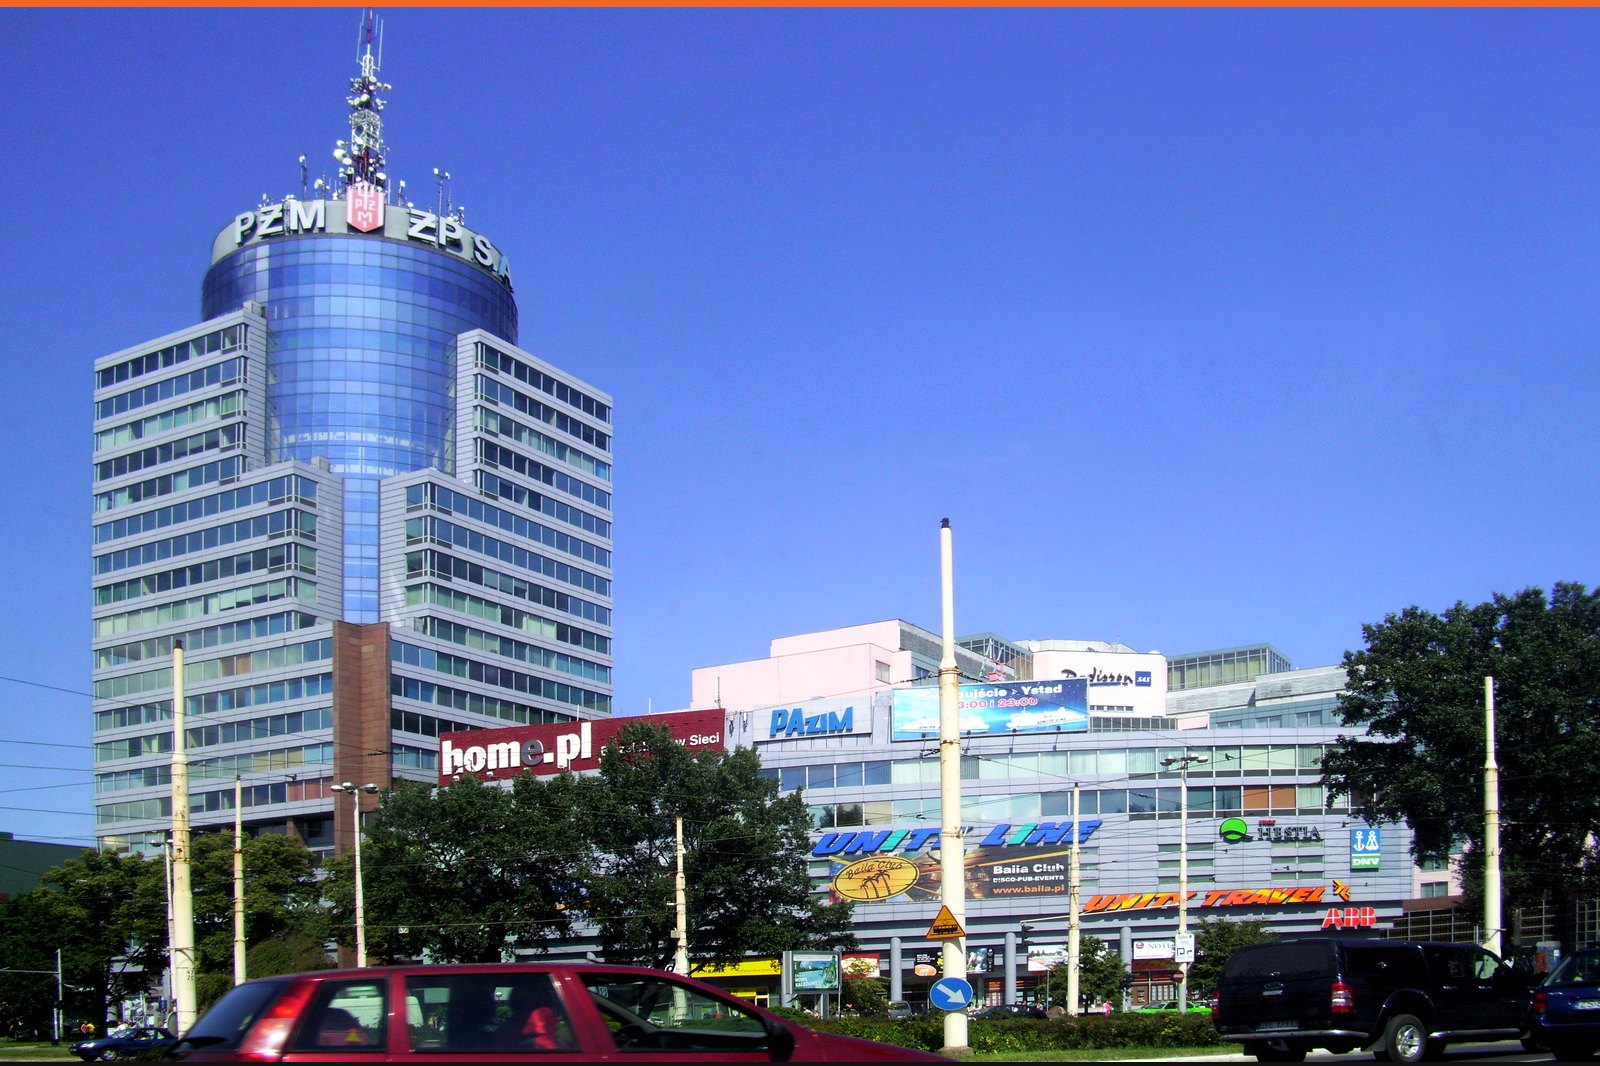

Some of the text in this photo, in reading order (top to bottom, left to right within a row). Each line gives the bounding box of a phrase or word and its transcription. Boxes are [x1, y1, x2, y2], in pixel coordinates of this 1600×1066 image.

[1061, 667, 1134, 683] Rdisson
[1021, 684, 1063, 695] Ystad
[998, 697, 1038, 708] 23:00
[689, 732, 720, 746] Sieci
[442, 722, 592, 776] home.pl
[979, 820, 1103, 848] LINE
[1257, 826, 1321, 839] HESTIA
[1033, 863, 1065, 873] Club
[1352, 857, 1380, 866] DNV
[1082, 886, 1326, 914] UNITY TRAVEL
[1321, 907, 1377, 928] ABB
